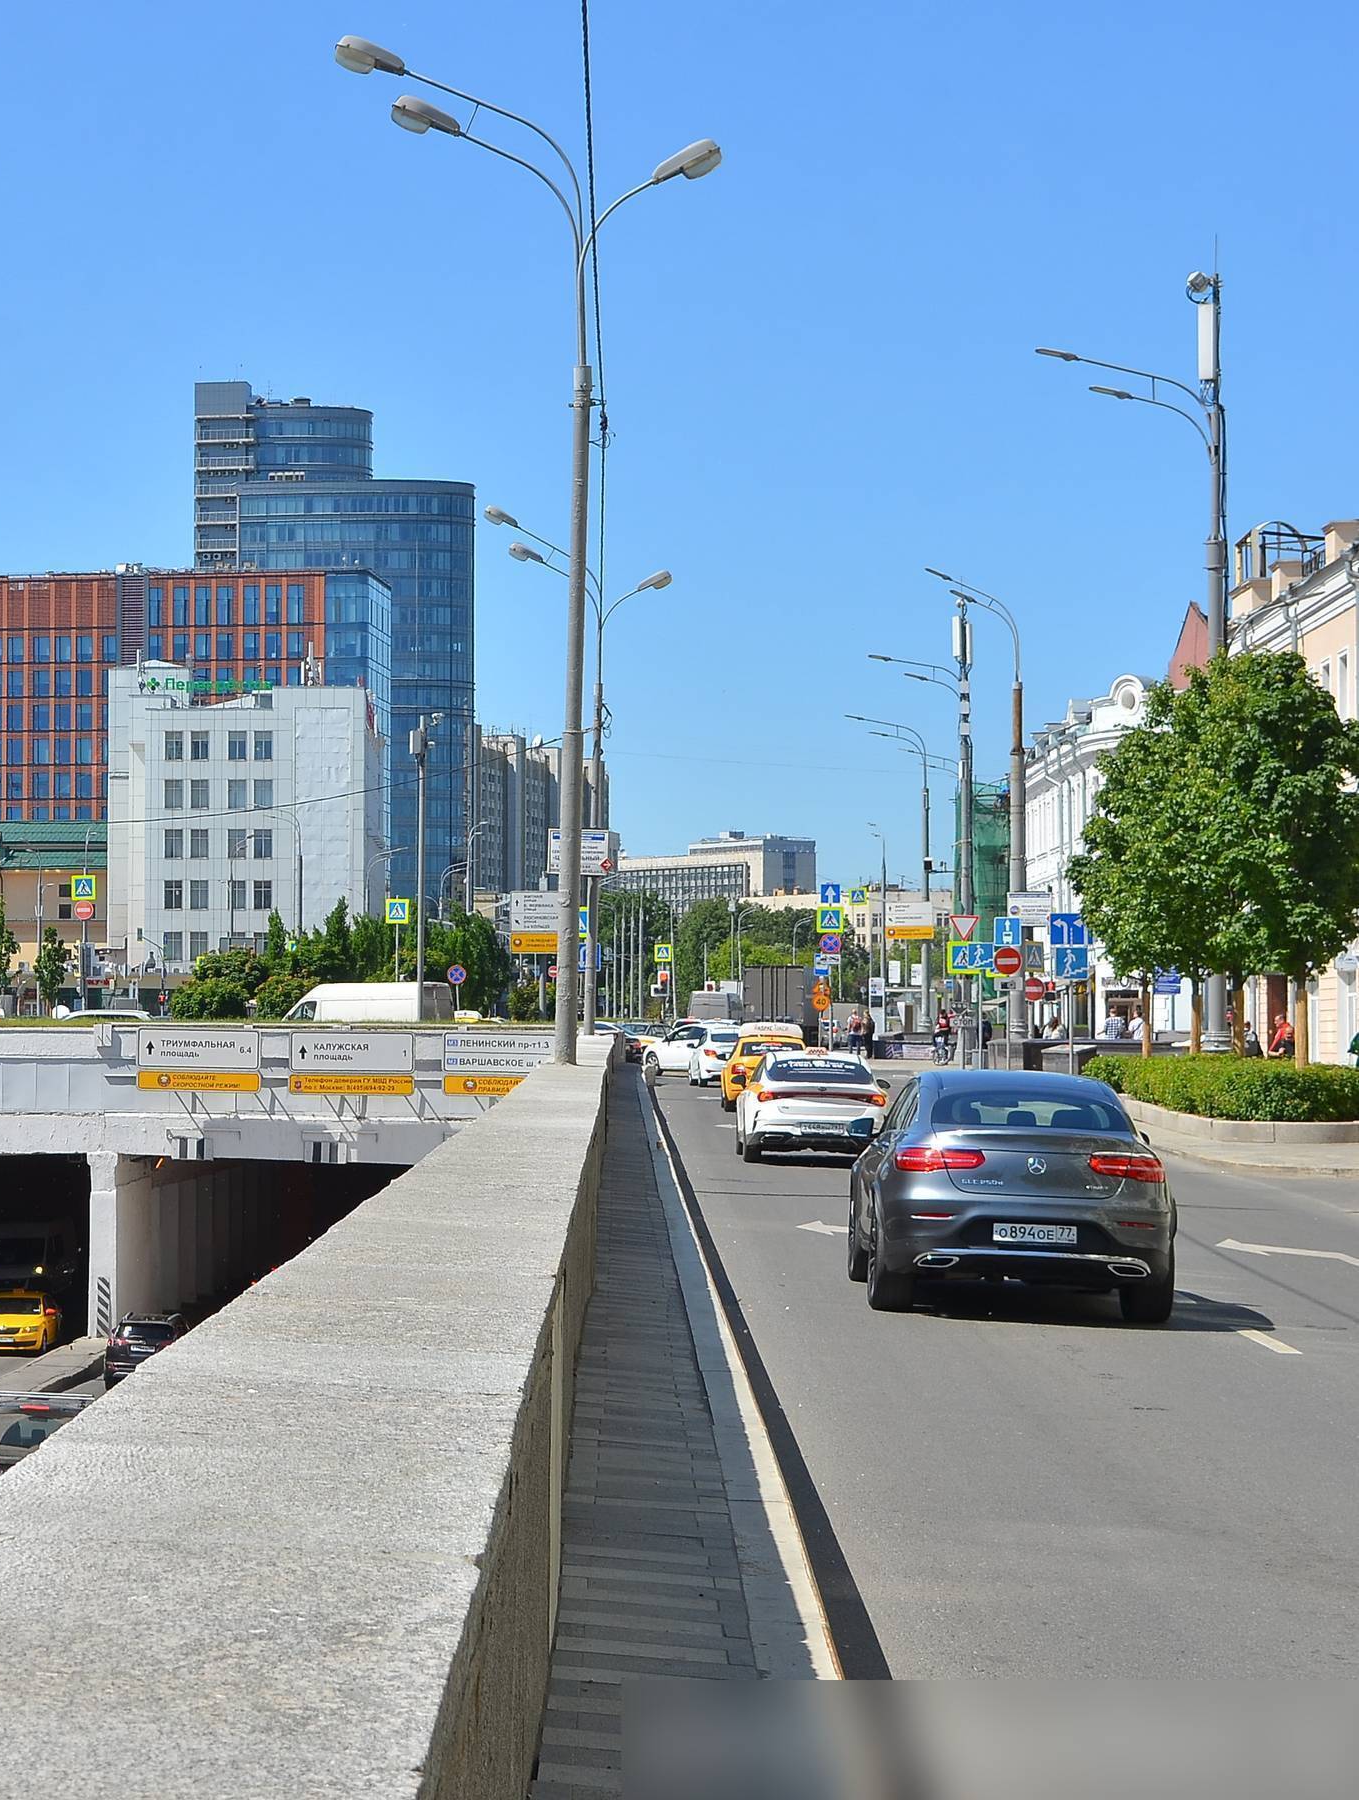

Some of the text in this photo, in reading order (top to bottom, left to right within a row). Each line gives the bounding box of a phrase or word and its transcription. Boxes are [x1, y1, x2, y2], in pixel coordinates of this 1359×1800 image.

[161, 1040, 236, 1048] ТРИУМФАЛЬНАЯ
[314, 1043, 369, 1051] КАЛУЖСКАЯ
[460, 1040, 516, 1048] ЛЕНИНСКИЙ
[460, 1058, 524, 1067] ВАРШАВСКОЕ
[998, 1226, 1072, 1240] О894ОЕ 77
